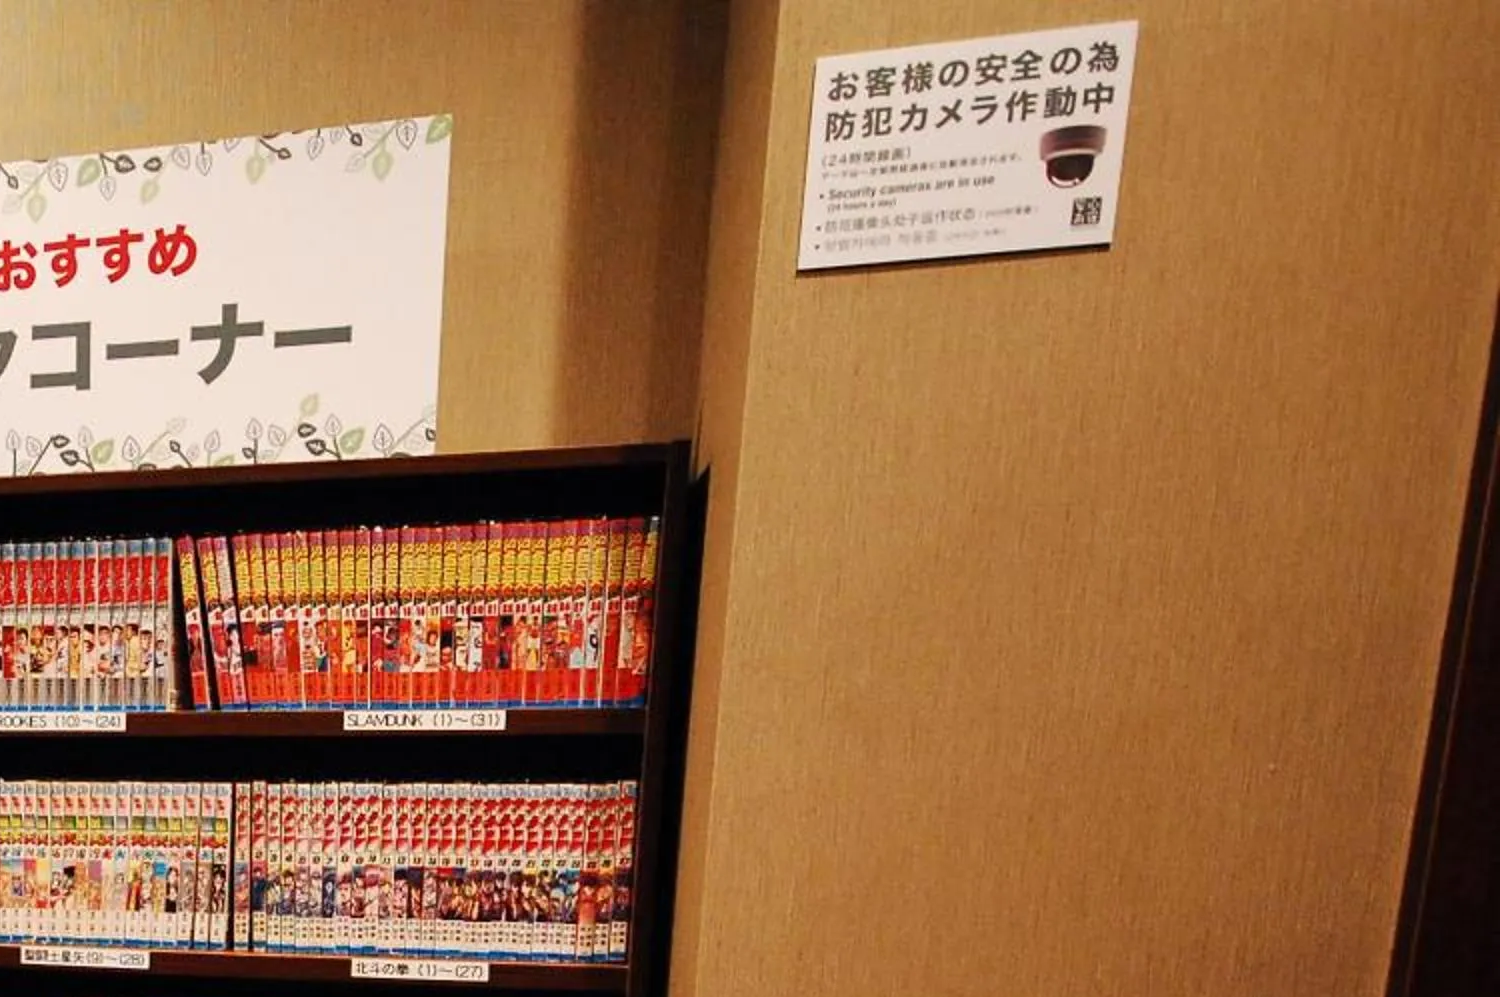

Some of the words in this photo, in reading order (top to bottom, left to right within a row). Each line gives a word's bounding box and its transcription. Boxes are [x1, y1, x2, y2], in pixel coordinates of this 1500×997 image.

[826, 41, 1120, 101] お客様の安全の為
[824, 82, 1115, 142] 防犯カメラ作動中
[828, 184, 876, 201] Security
[879, 180, 931, 196] cameras
[934, 180, 955, 190] are
[973, 175, 995, 187] use
